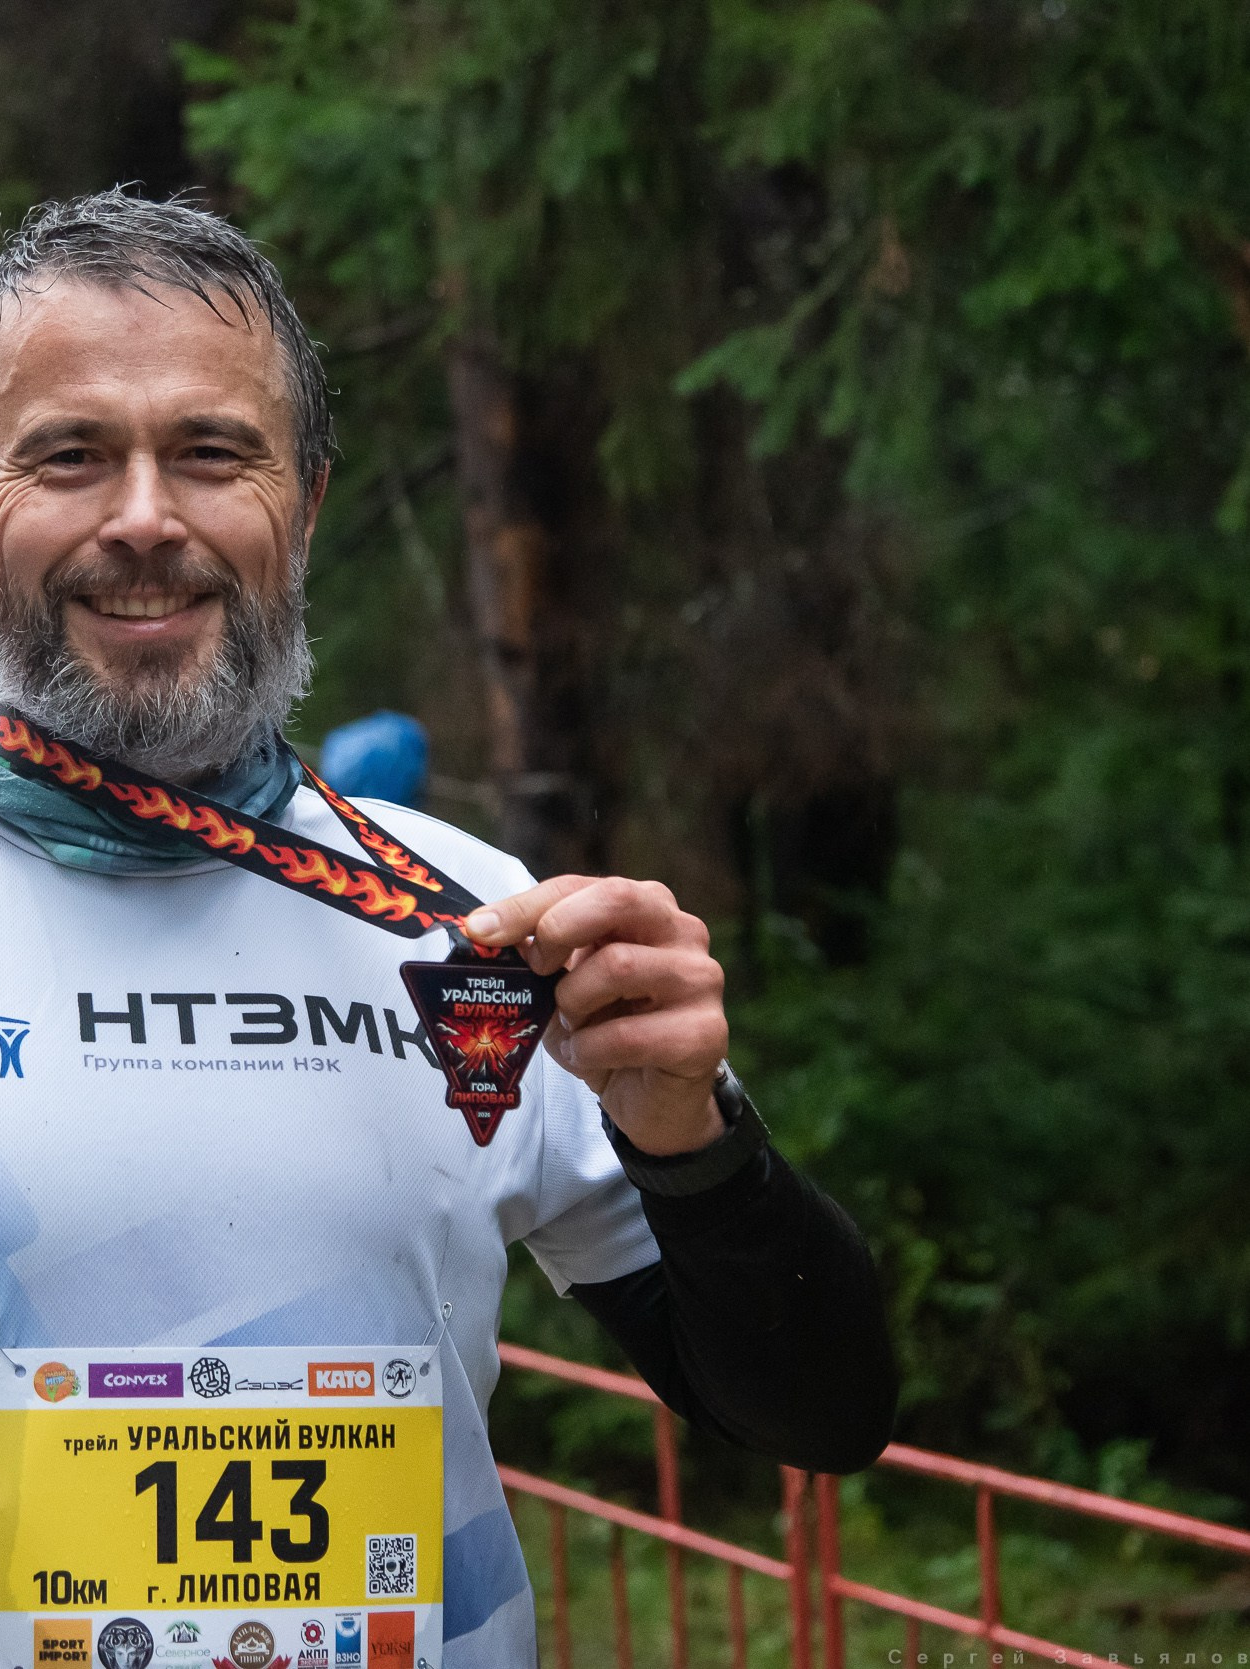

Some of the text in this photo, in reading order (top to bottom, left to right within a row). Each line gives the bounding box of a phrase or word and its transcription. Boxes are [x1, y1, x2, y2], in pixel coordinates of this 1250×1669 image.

[466, 978, 505, 989] ТРЕЙЛ
[442, 989, 532, 1005] УРАЛЬСКИЙ
[454, 1003, 519, 1018] ВУЛКАН
[77, 992, 443, 1070] НТЗМК
[83, 1054, 341, 1073] Группа компании НЭК
[471, 1083, 498, 1092] ГОРА
[453, 1092, 515, 1104] ЛИПОВАЯ
[63, 1419, 396, 1453] трейл УРАЛЬСКИЙ ВУЛКАН
[135, 1459, 330, 1565] 143
[147, 1586, 167, 1604] г.
[177, 1572, 322, 1603] ЛИПОВАЯ
[42, 1639, 85, 1649] SPORT
[39, 1651, 88, 1661] IMPORT
[298, 1649, 329, 1659] АКПП
